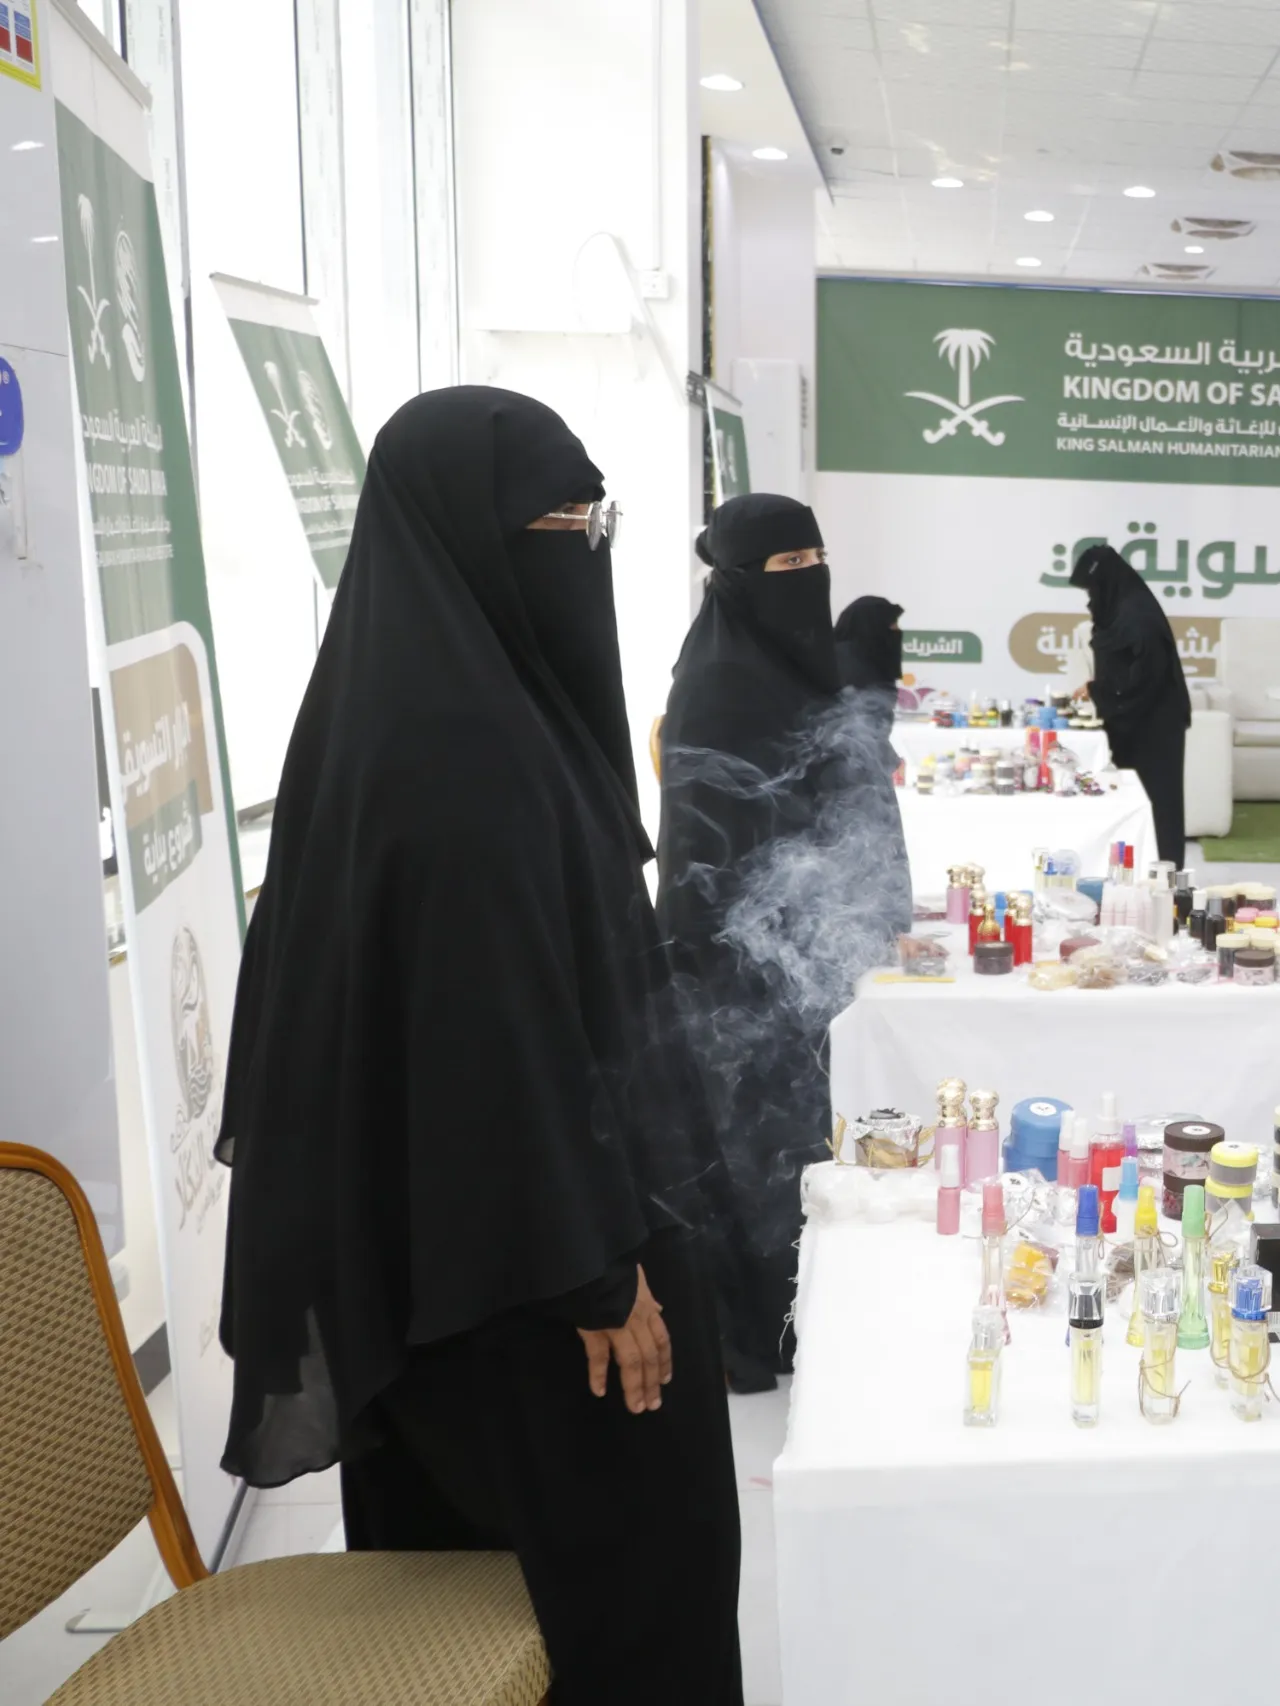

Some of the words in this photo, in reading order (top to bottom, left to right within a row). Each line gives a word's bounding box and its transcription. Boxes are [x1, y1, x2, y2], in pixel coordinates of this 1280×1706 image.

[1063, 331, 1212, 368] السعودية
[1062, 374, 1201, 404] KINGDOM
[1206, 381, 1244, 405] OF
[1056, 436, 1095, 452] KING
[1097, 437, 1164, 455] SALMAN
